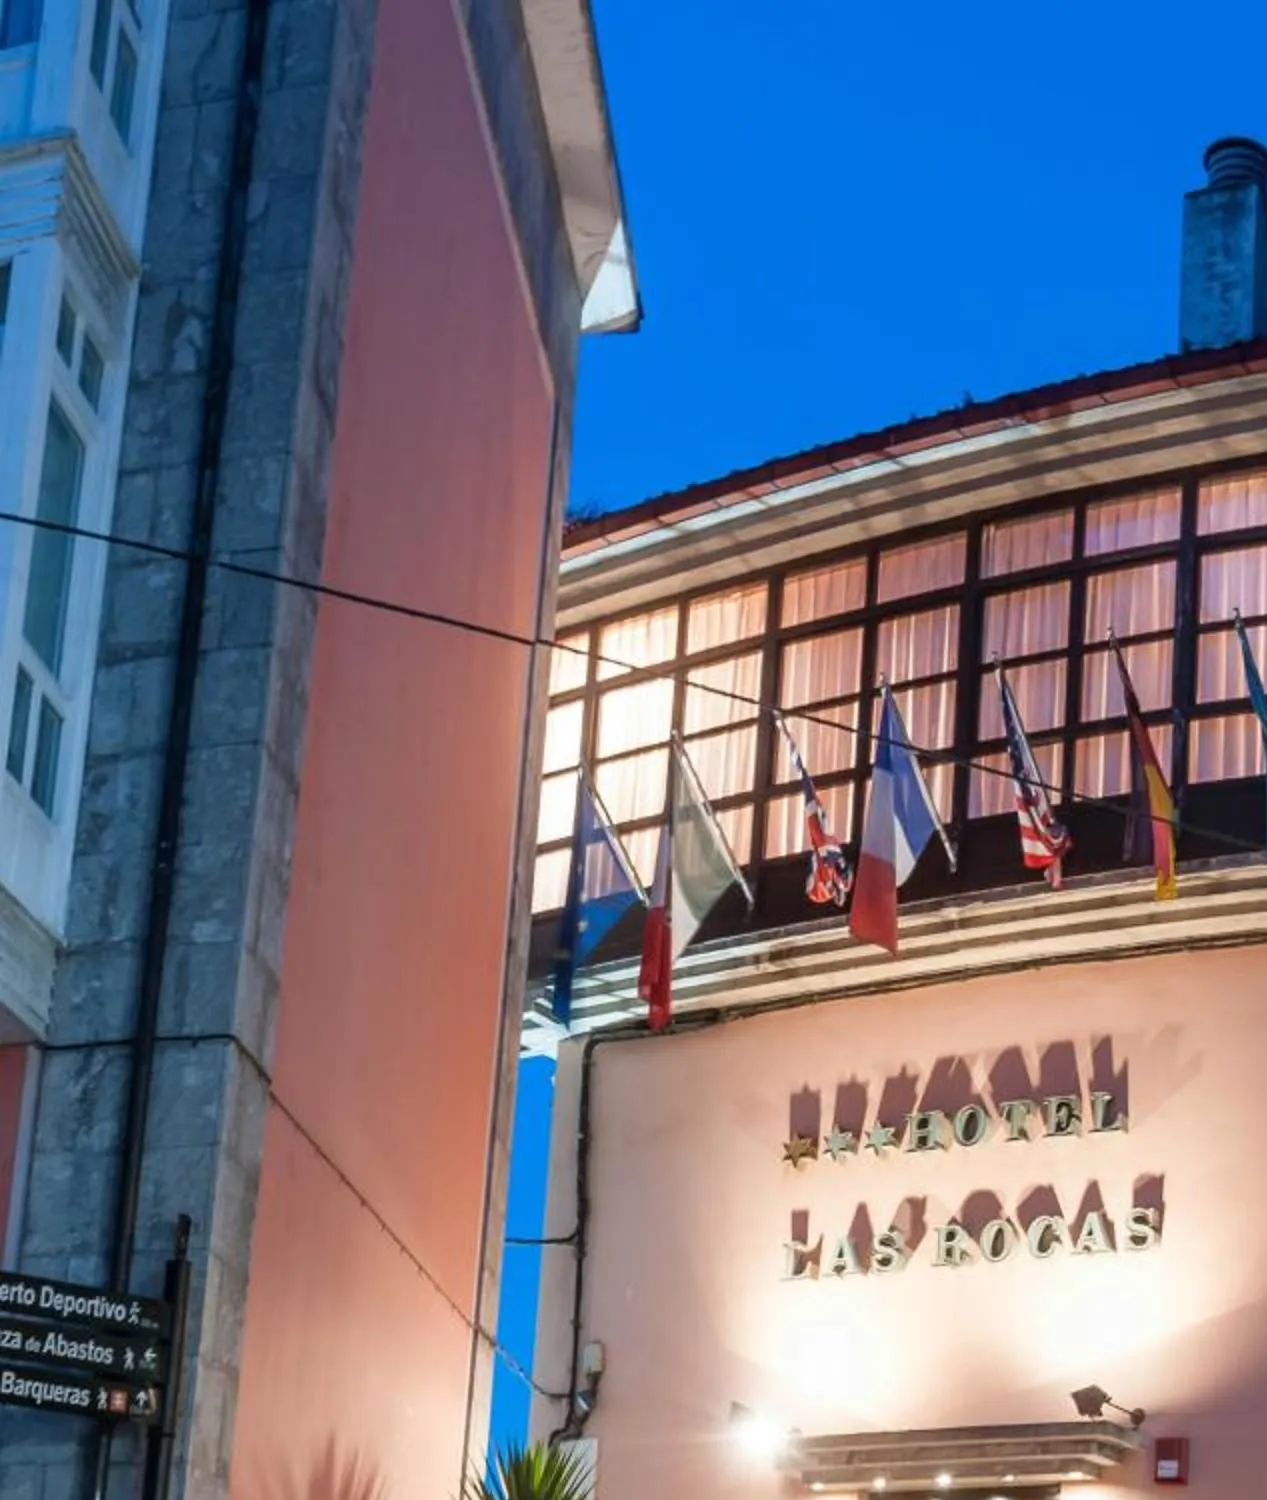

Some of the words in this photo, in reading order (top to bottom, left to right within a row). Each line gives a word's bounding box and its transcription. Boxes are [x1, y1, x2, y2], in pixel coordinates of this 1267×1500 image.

[904, 1092, 1124, 1153] HOTEL
[780, 1230, 906, 1281] LAS
[931, 1207, 1158, 1266] ROCAS
[39, 1285, 127, 1322] Deportivo
[25, 1336, 41, 1352] de
[43, 1332, 114, 1364] Abastos
[1, 1371, 91, 1407] Barqueras
